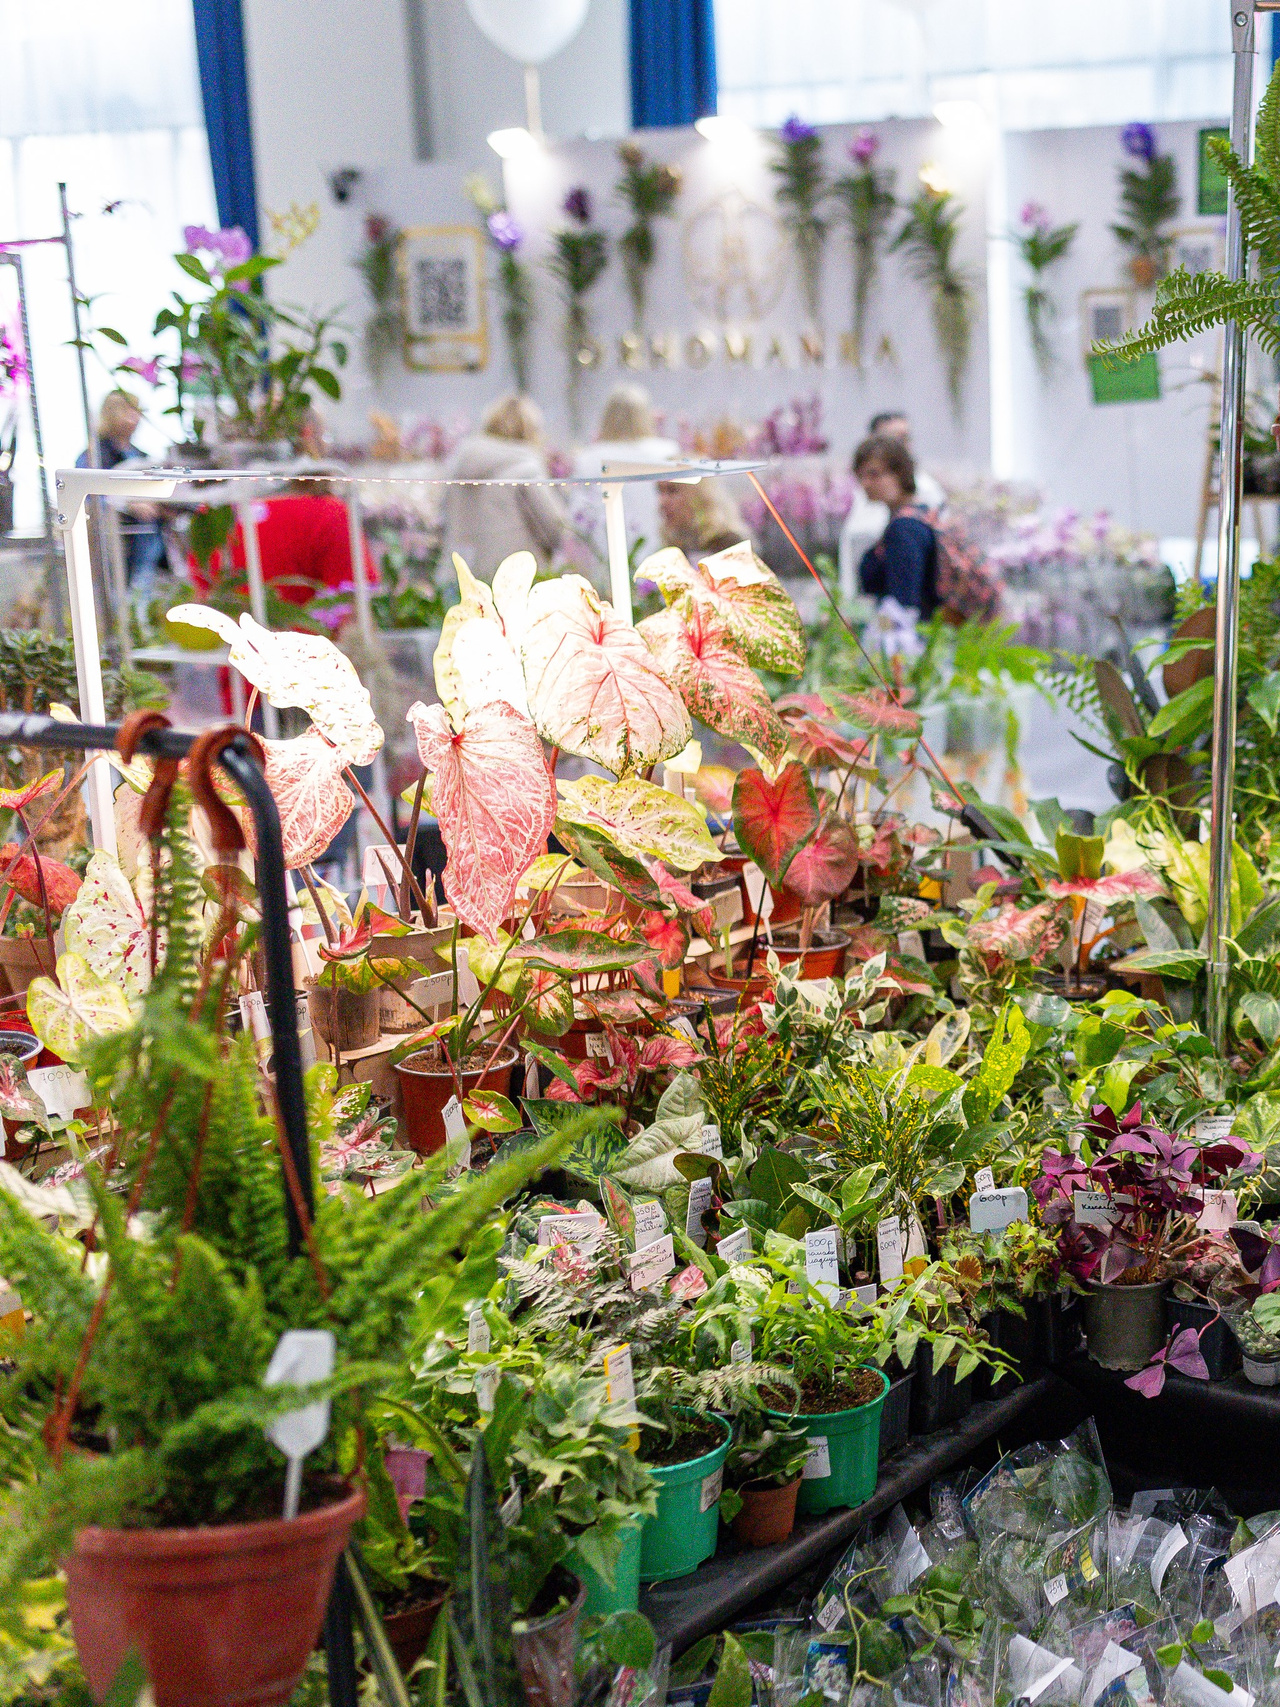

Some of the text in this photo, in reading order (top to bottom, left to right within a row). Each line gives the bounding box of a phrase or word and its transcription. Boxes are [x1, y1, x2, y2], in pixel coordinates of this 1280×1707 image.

[423, 974, 452, 988] 2500р
[39, 1070, 72, 1086] 700р
[978, 1193, 1008, 1207] 600р
[808, 1238, 833, 1252] 500р
